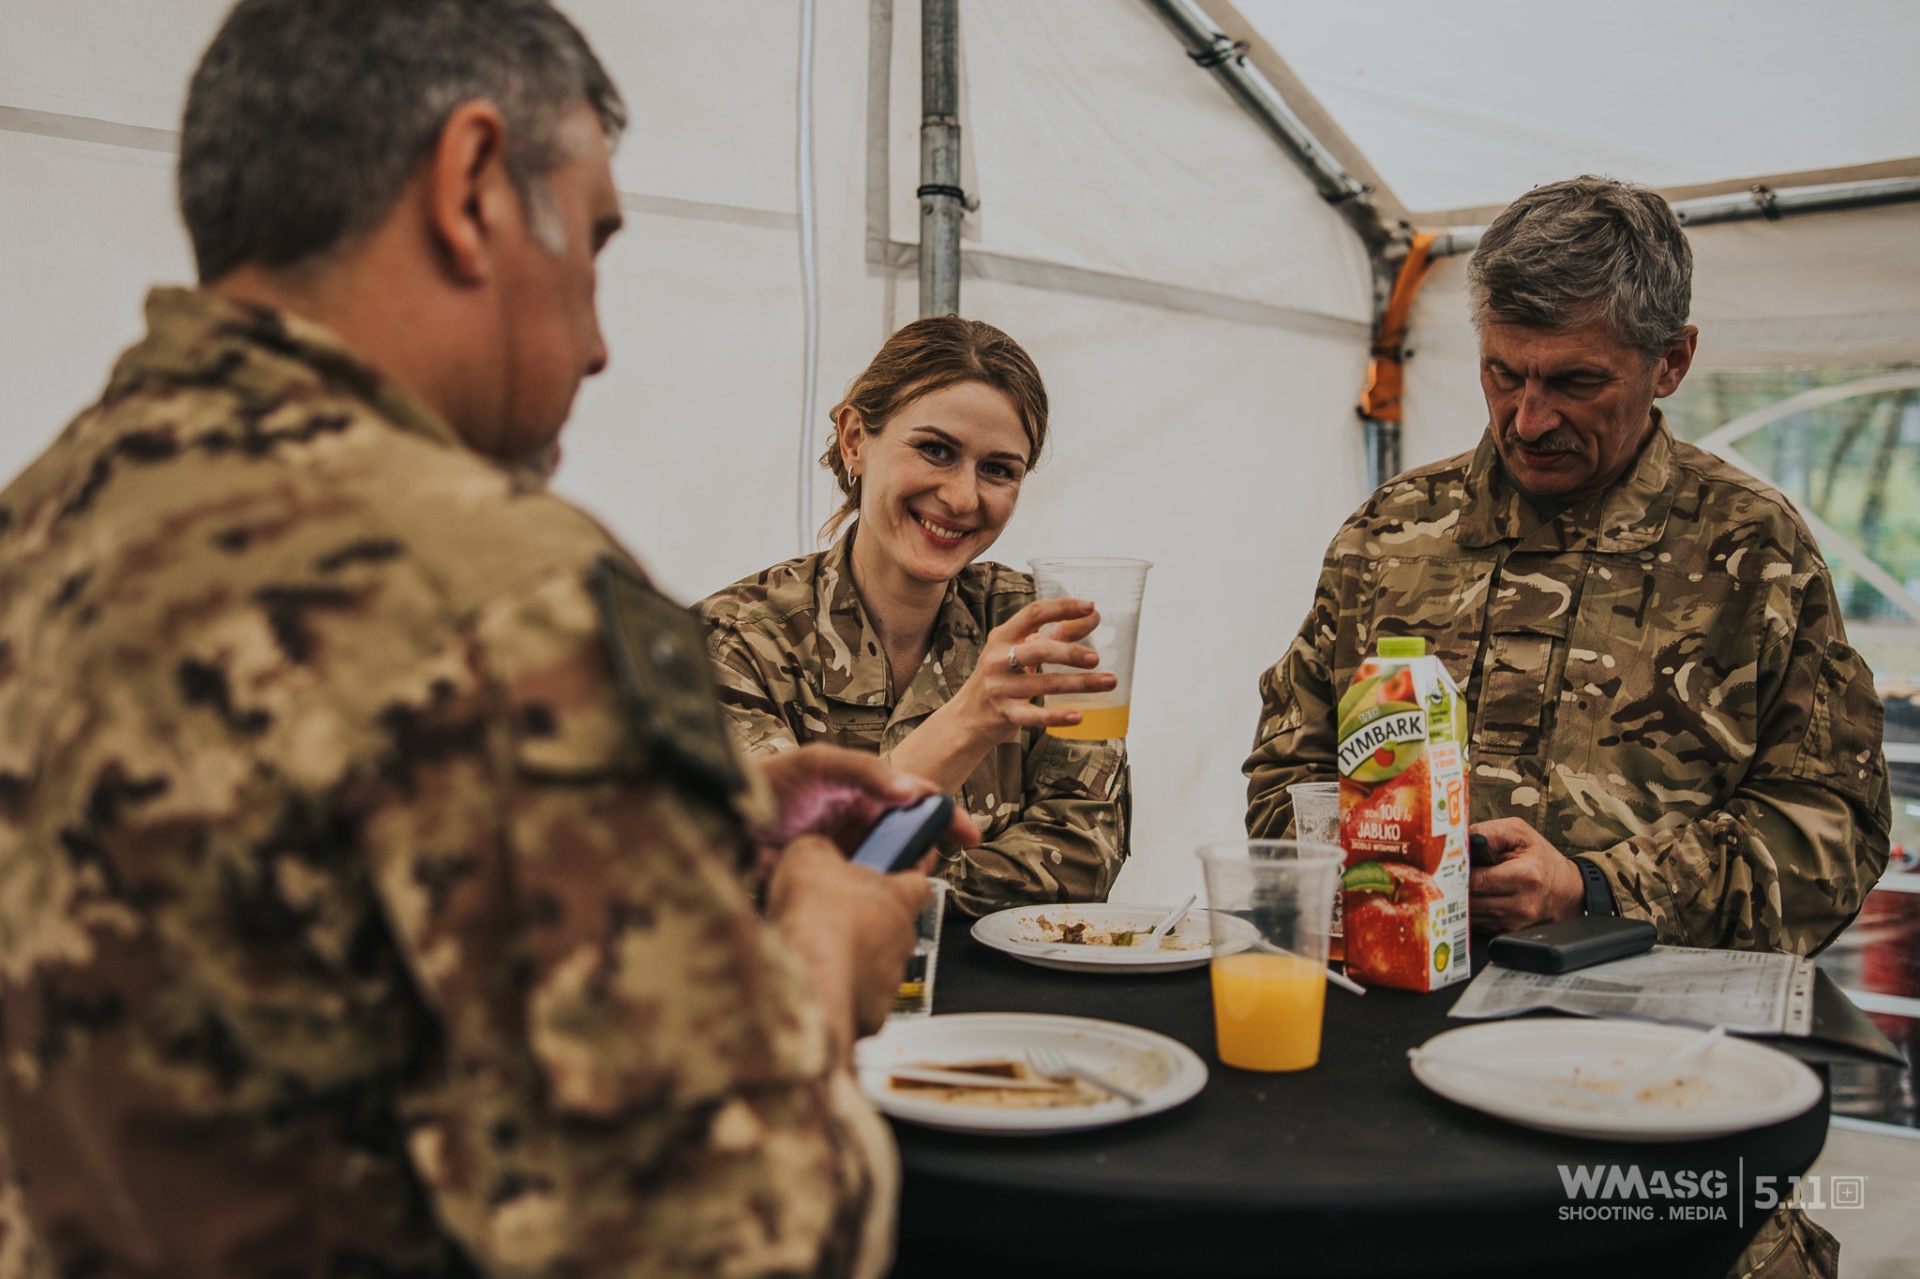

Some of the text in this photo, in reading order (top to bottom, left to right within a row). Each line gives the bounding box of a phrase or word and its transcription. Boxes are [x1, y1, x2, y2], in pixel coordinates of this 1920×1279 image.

[1338, 716, 1422, 767] TYMBARK
[1380, 803, 1412, 822] 100%
[1358, 822, 1400, 841] JABŁKO
[1401, 843, 1408, 854] C
